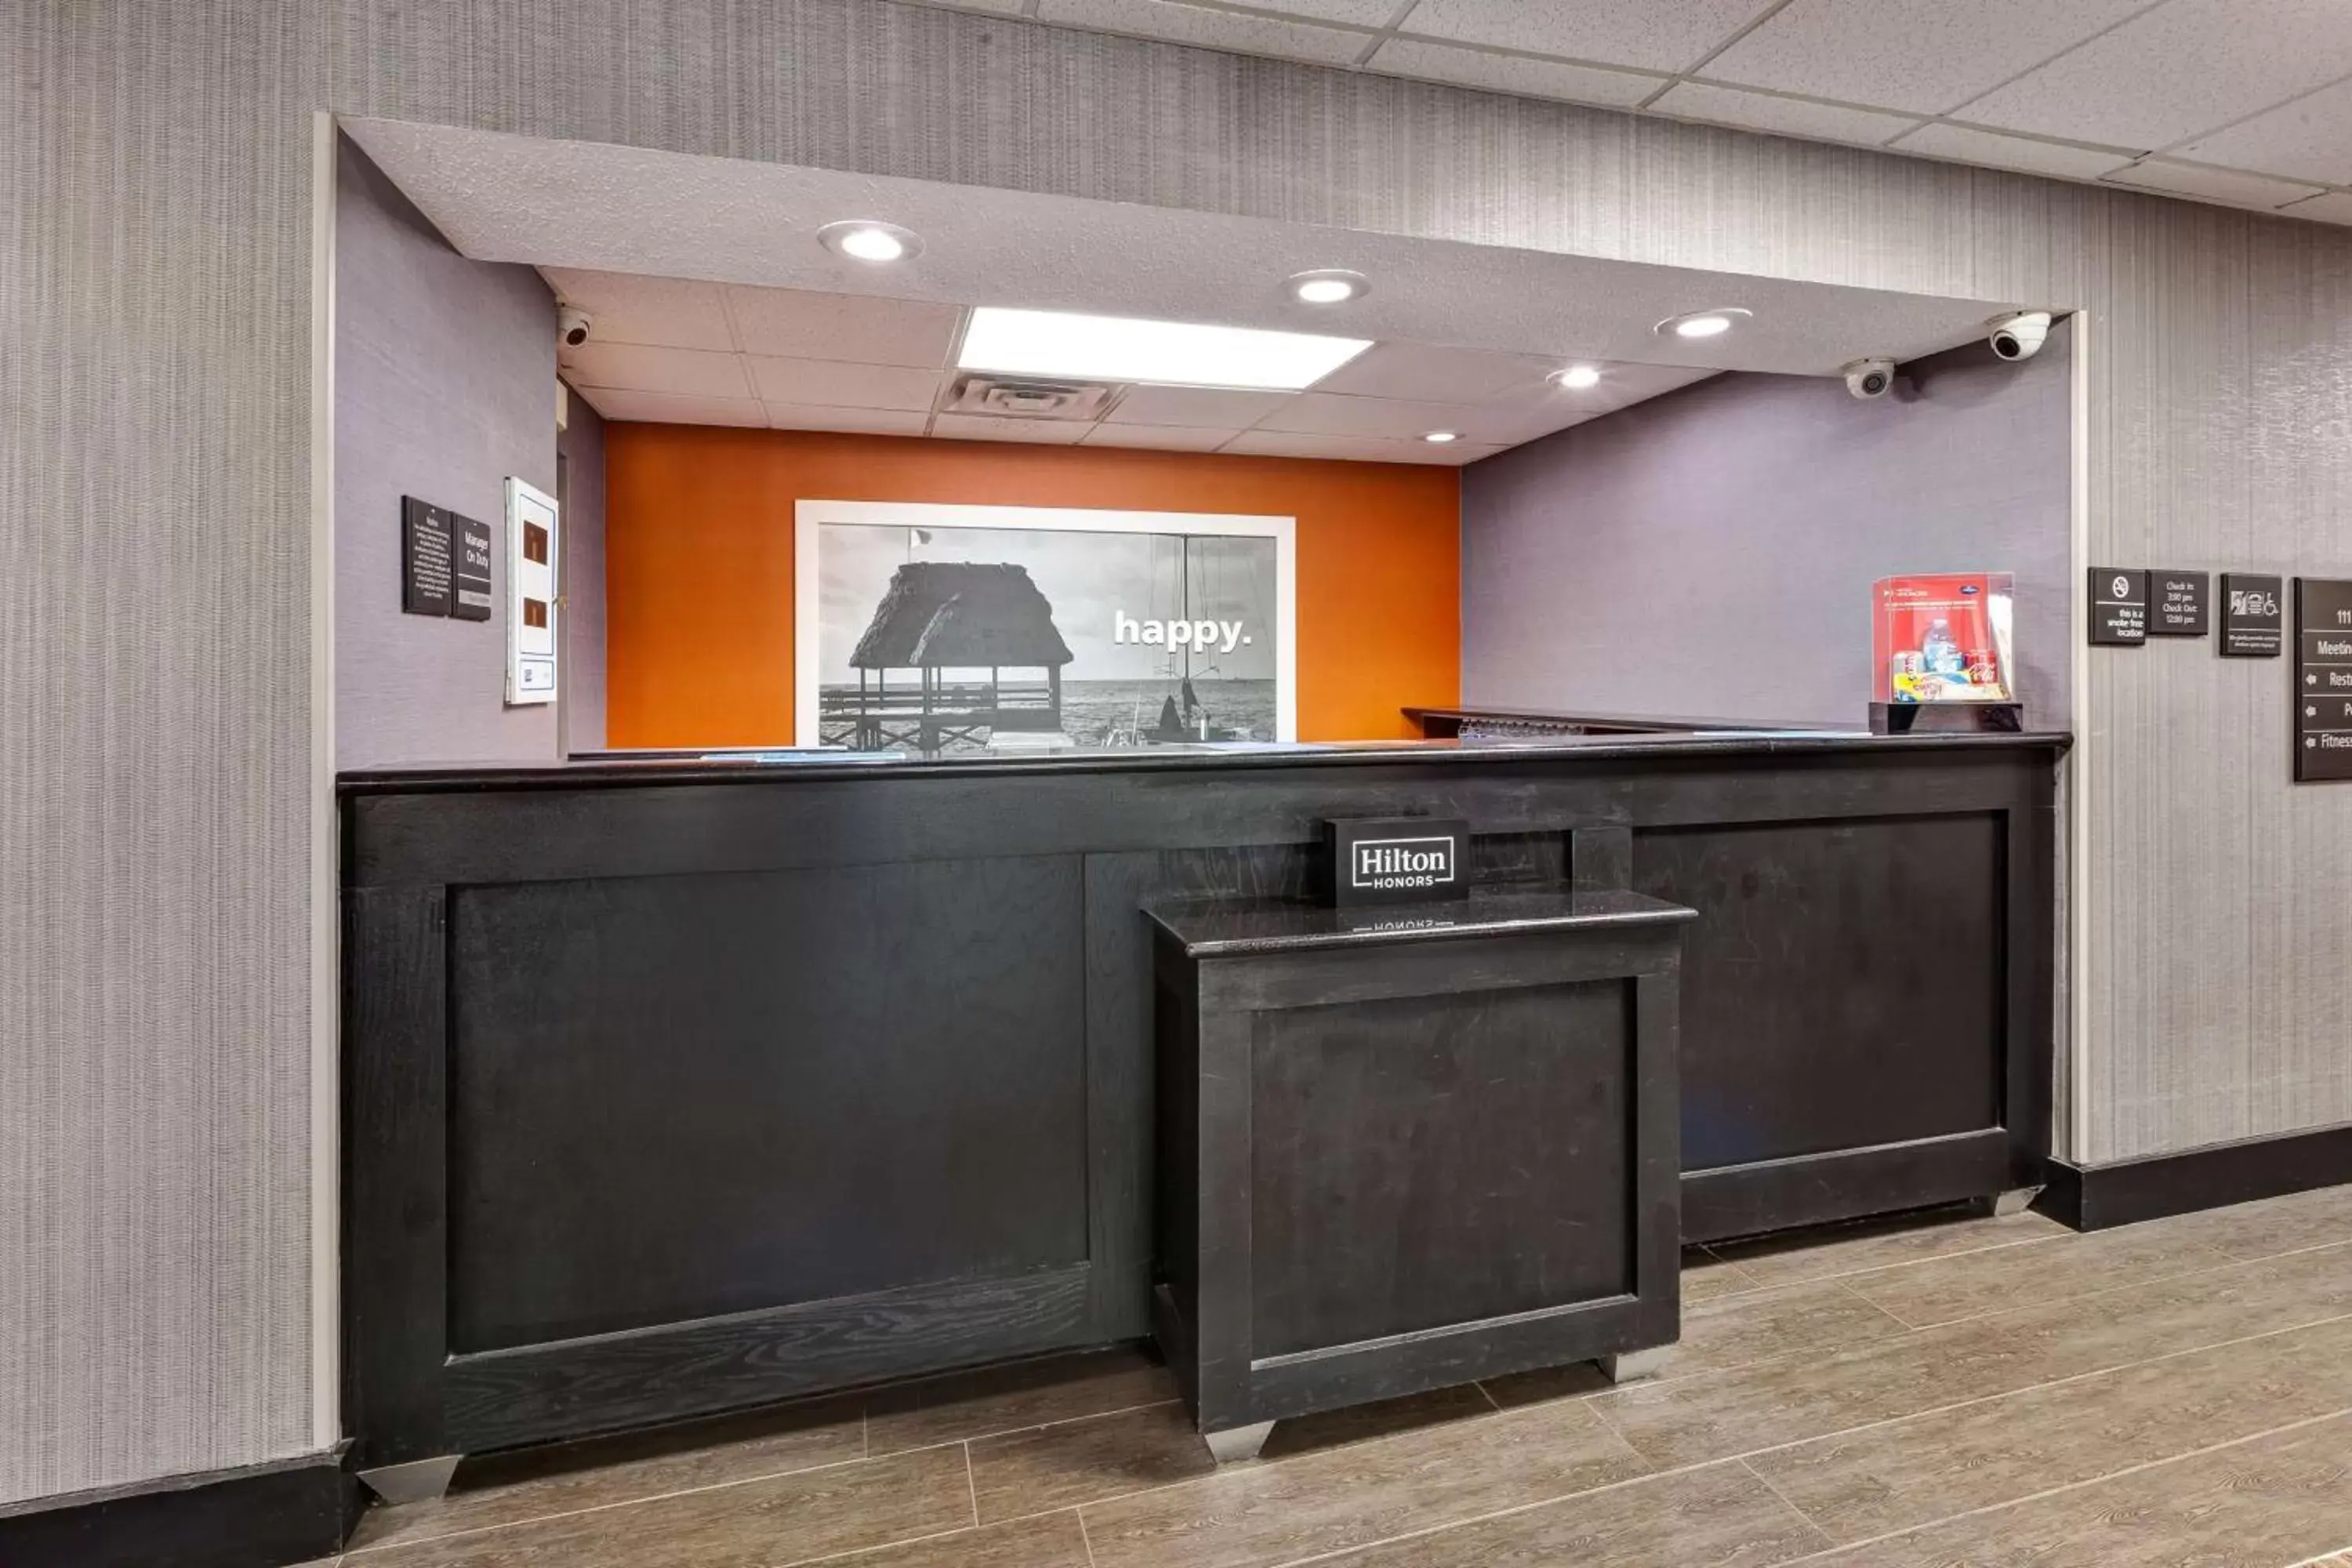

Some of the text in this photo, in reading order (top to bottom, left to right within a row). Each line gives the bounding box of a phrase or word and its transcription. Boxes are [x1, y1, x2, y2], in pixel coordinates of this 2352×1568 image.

[2166, 581, 2185, 590] Check
[2162, 603, 2183, 612] Check
[1115, 610, 1252, 653] happy.
[2317, 640, 2352, 655] Meetin
[1361, 848, 1446, 874] Hilton
[1374, 874, 1434, 889] HONORS
